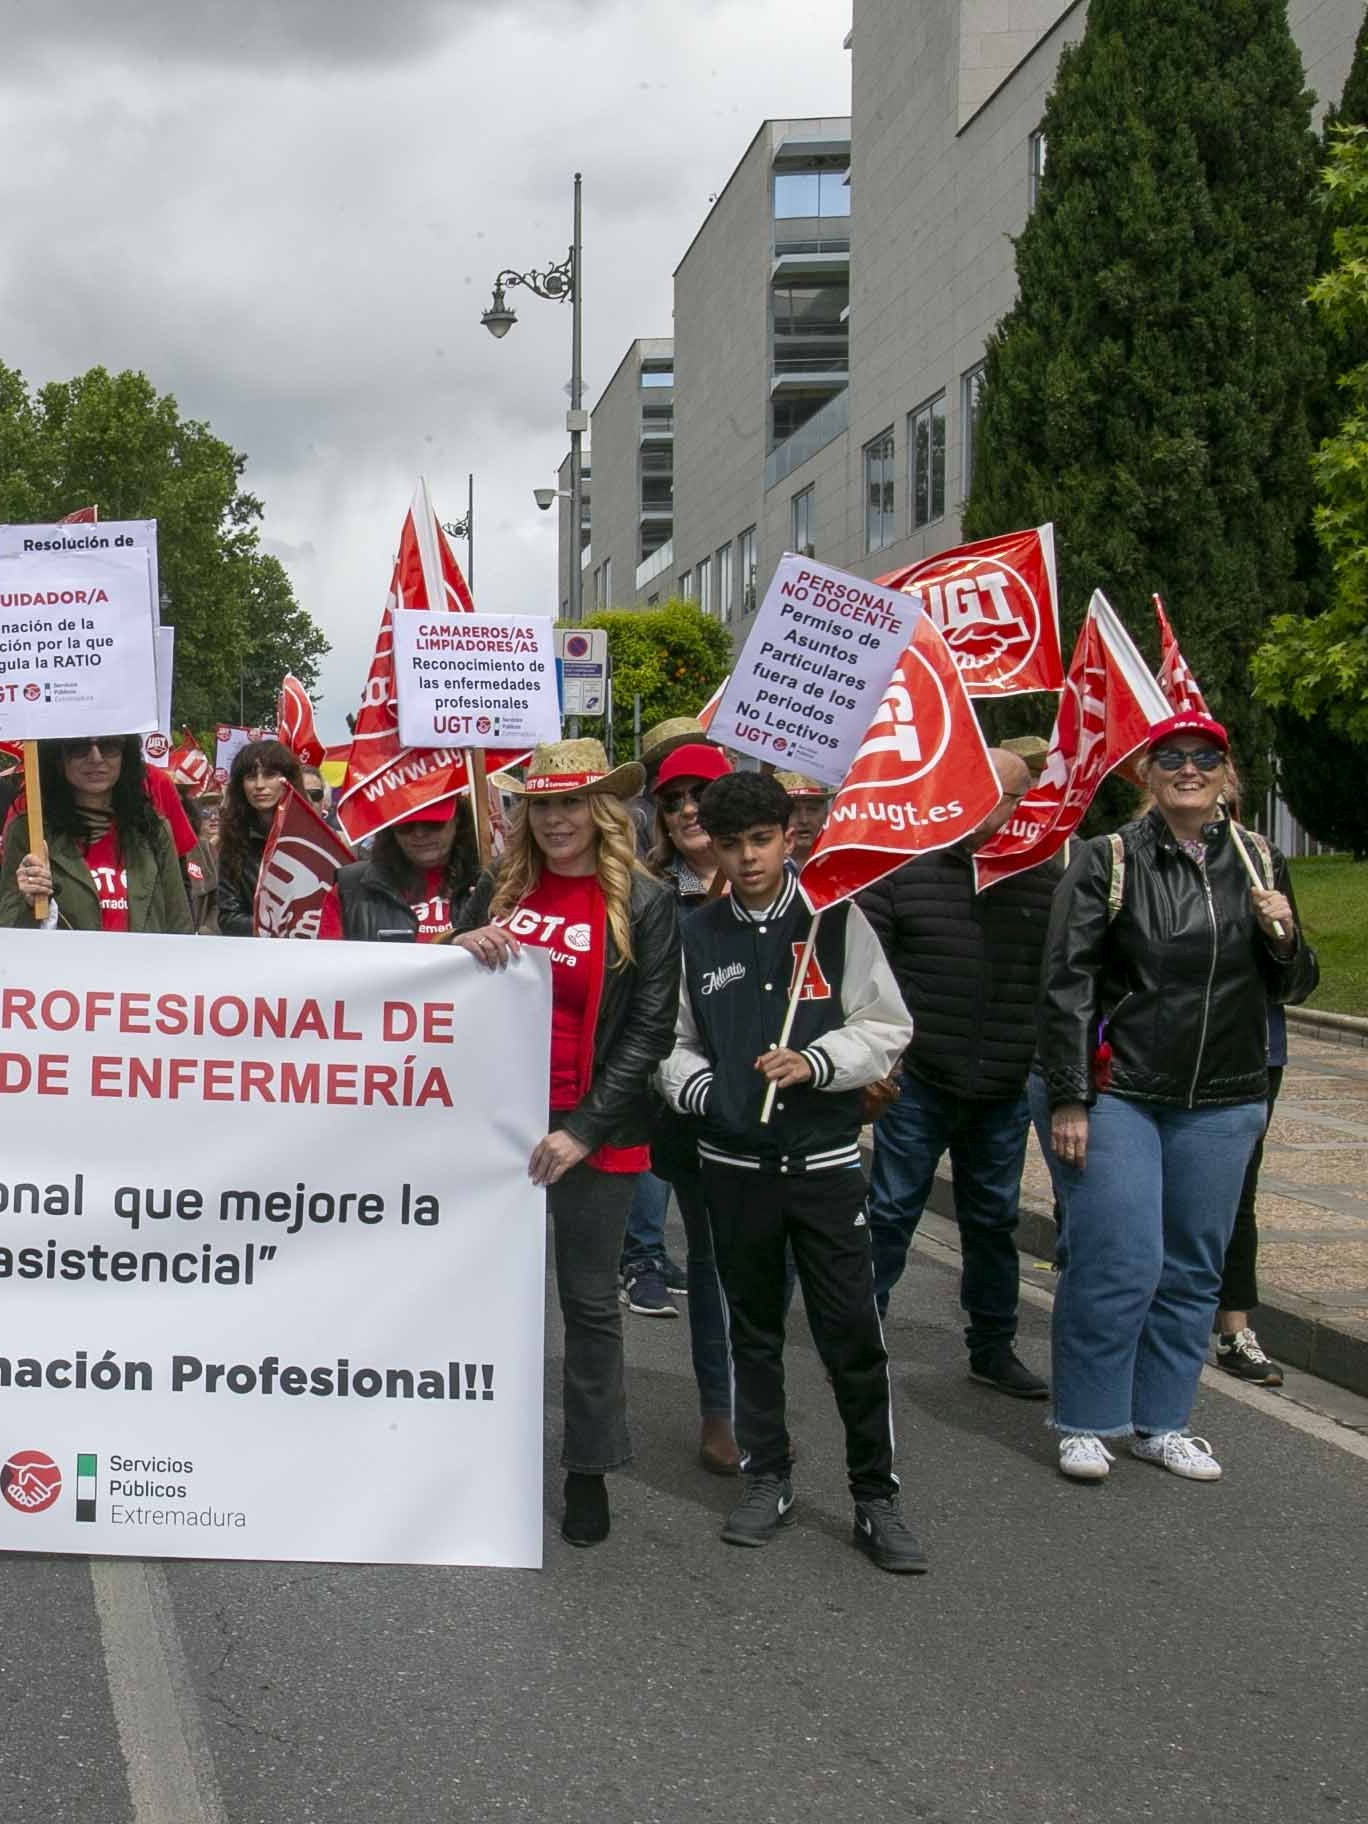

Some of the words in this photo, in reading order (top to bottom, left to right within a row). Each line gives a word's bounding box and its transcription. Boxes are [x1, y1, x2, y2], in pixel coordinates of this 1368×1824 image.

[23, 535, 108, 551] Resolución
[114, 534, 134, 548] de
[781, 581, 809, 600] NO
[812, 592, 902, 634] DOCENTE
[797, 571, 896, 616] PERSONAL
[58, 619, 76, 632] de
[81, 618, 94, 630] la
[418, 624, 534, 640] CAMAREROS/AS
[780, 603, 854, 640] Permiso
[858, 633, 881, 649] de
[35, 656, 48, 669] la
[53, 654, 101, 668] RATIO
[37, 639, 62, 658] por
[67, 637, 80, 649] la
[86, 637, 113, 655] que
[416, 638, 538, 654] LIMPIADORES/AS
[783, 628, 859, 665] Asuntos
[412, 656, 525, 672] Reconocimiento
[529, 659, 545, 672] de
[759, 641, 867, 691] Particulares
[418, 675, 439, 690] las
[444, 676, 541, 692] enfermedades
[752, 661, 798, 690] fuera
[802, 681, 824, 698] de
[829, 689, 856, 710] los
[435, 695, 529, 713] profesionales
[755, 688, 835, 725] periodos
[433, 715, 473, 734] UGT
[734, 722, 772, 746] UGT
[736, 701, 760, 720] No
[764, 711, 841, 749] Lectivos
[363, 748, 464, 803] www.ug
[822, 799, 964, 831] w.ugt.es
[787, 941, 832, 1001] A
[383, 1000, 455, 1044] DE
[91, 1055, 454, 1108] ENFERMERÍA
[114, 1185, 204, 1229] que
[220, 1182, 385, 1234] mejore
[401, 1183, 440, 1226] la
[171, 1355, 495, 1401] Profesional!!
[110, 1454, 194, 1475] Servicios
[110, 1479, 187, 1499] Públicos
[110, 1504, 247, 1529] Extremadura
